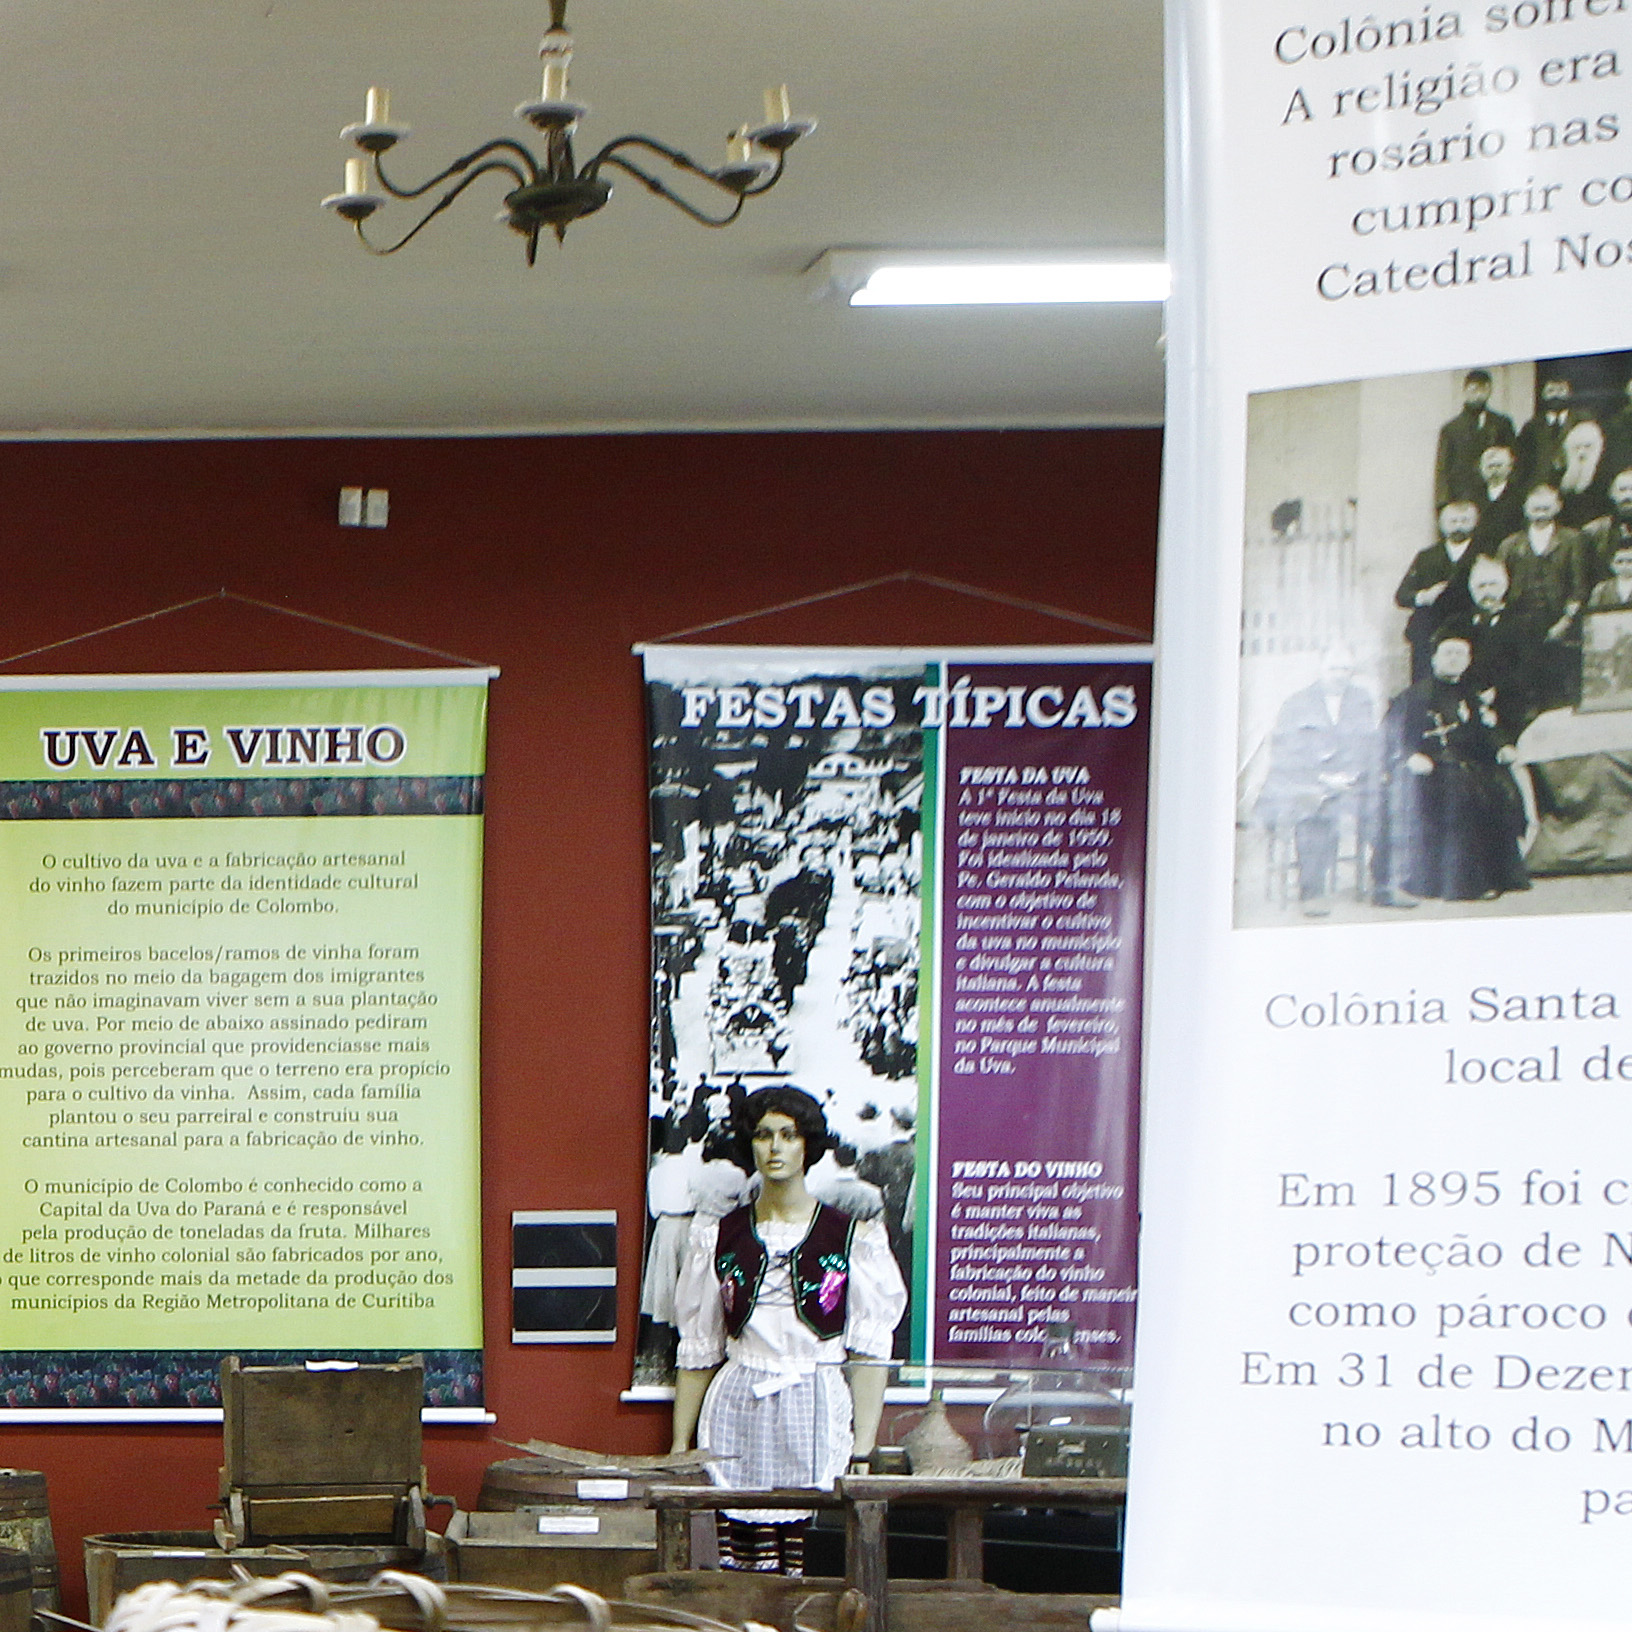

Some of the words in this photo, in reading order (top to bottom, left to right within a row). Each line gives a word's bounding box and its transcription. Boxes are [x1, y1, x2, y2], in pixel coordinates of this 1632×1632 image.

[1275, 5, 1463, 65] Colônia
[1281, 88, 1314, 126] A
[1332, 62, 1519, 115] religião
[1540, 49, 1621, 87] era
[1327, 123, 1505, 178] rosário
[1528, 113, 1620, 151] nas
[1352, 178, 1564, 234] cumprir
[1317, 239, 1533, 301] Catedral
[1554, 232, 1632, 274] No
[681, 685, 895, 728] FESTAS
[913, 675, 1138, 728] TÍPICAS
[42, 729, 155, 767] UVA
[173, 728, 208, 765] E
[225, 726, 404, 764] VINHO
[1021, 766, 1049, 785] DA
[1051, 766, 1091, 785] UVA
[41, 853, 57, 869] O
[61, 852, 122, 869] cultivo
[126, 851, 149, 868] da
[155, 856, 187, 868] uva
[192, 855, 203, 868] e
[208, 855, 219, 868] a
[225, 850, 317, 870] fabricação
[322, 849, 405, 867] artesanal
[106, 898, 129, 915] do
[135, 897, 224, 919] município
[228, 897, 250, 914] de
[255, 896, 338, 914] Colombo.
[1264, 988, 1450, 1030] Colônia
[1468, 986, 1620, 1024] Santa
[1443, 1045, 1563, 1085] local
[952, 1161, 1011, 1178] FESTA
[1014, 1161, 1042, 1178] DO
[1045, 1161, 1103, 1178] VINHO
[1277, 1172, 1356, 1208] Em
[1382, 1171, 1501, 1208] 1895
[1521, 1169, 1582, 1207] foi
[38, 1200, 102, 1221] Capital
[107, 1200, 130, 1216] da
[136, 1200, 170, 1217] Uva
[175, 1199, 197, 1216] do
[203, 1200, 266, 1216] Paraná
[271, 1203, 281, 1216] e
[286, 1199, 296, 1216] é
[302, 1198, 407, 1220] responsável
[1035, 1264, 1057, 1281] do
[1291, 1234, 1504, 1276] proteção
[1524, 1232, 1582, 1269] de
[10, 1293, 108, 1314] municípios
[113, 1292, 135, 1309] da
[142, 1292, 200, 1314] Região
[205, 1292, 329, 1313] Metropolitana
[334, 1291, 356, 1308] de
[361, 1291, 435, 1308] Curitiba
[1287, 1301, 1417, 1329] como
[1436, 1294, 1608, 1339] pároco
[1240, 1351, 1318, 1387] Em
[1338, 1352, 1395, 1388] 31
[1417, 1352, 1474, 1390] de
[1321, 1420, 1382, 1449] no
[1400, 1415, 1492, 1450] alto
[1511, 1415, 1572, 1454] do
